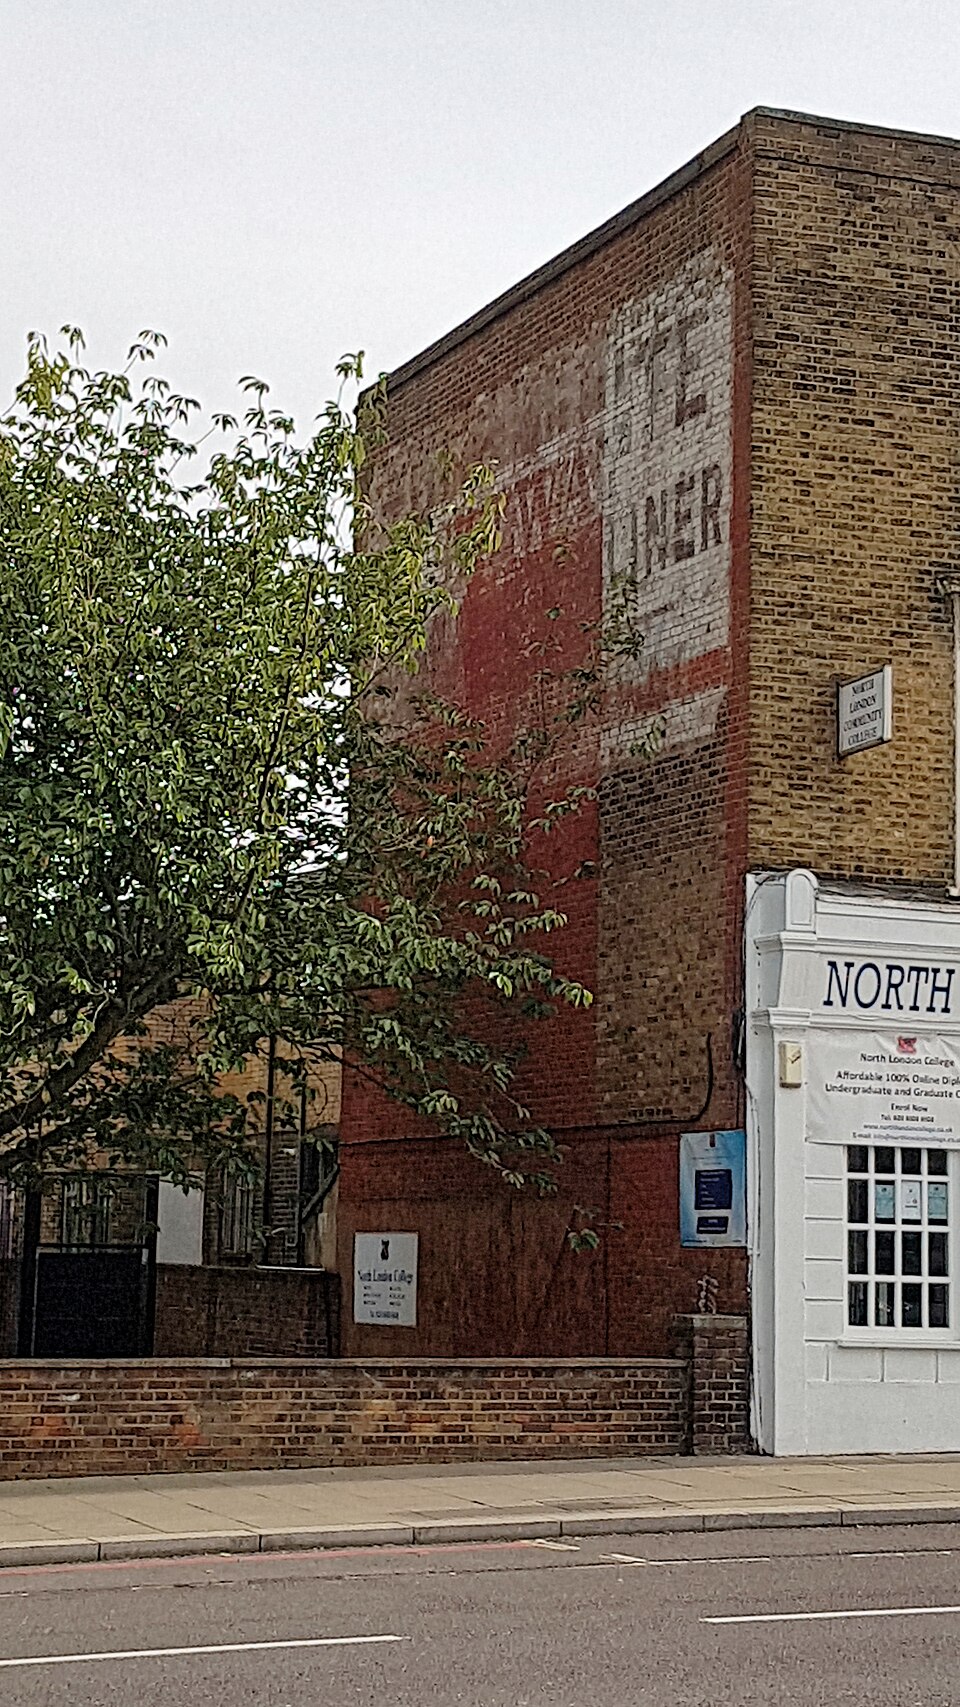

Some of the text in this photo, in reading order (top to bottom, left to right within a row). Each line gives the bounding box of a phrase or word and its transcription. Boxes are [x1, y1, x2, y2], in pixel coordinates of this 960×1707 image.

[823, 960, 956, 1014] NORTH
[860, 1053, 955, 1068] North London College
[836, 1071, 882, 1082] Affordable
[886, 1073, 910, 1083] 100%
[912, 1074, 940, 1084] Online
[825, 1083, 892, 1096] Undergraduate
[894, 1086, 911, 1096] and
[914, 1087, 953, 1098] Graduate
